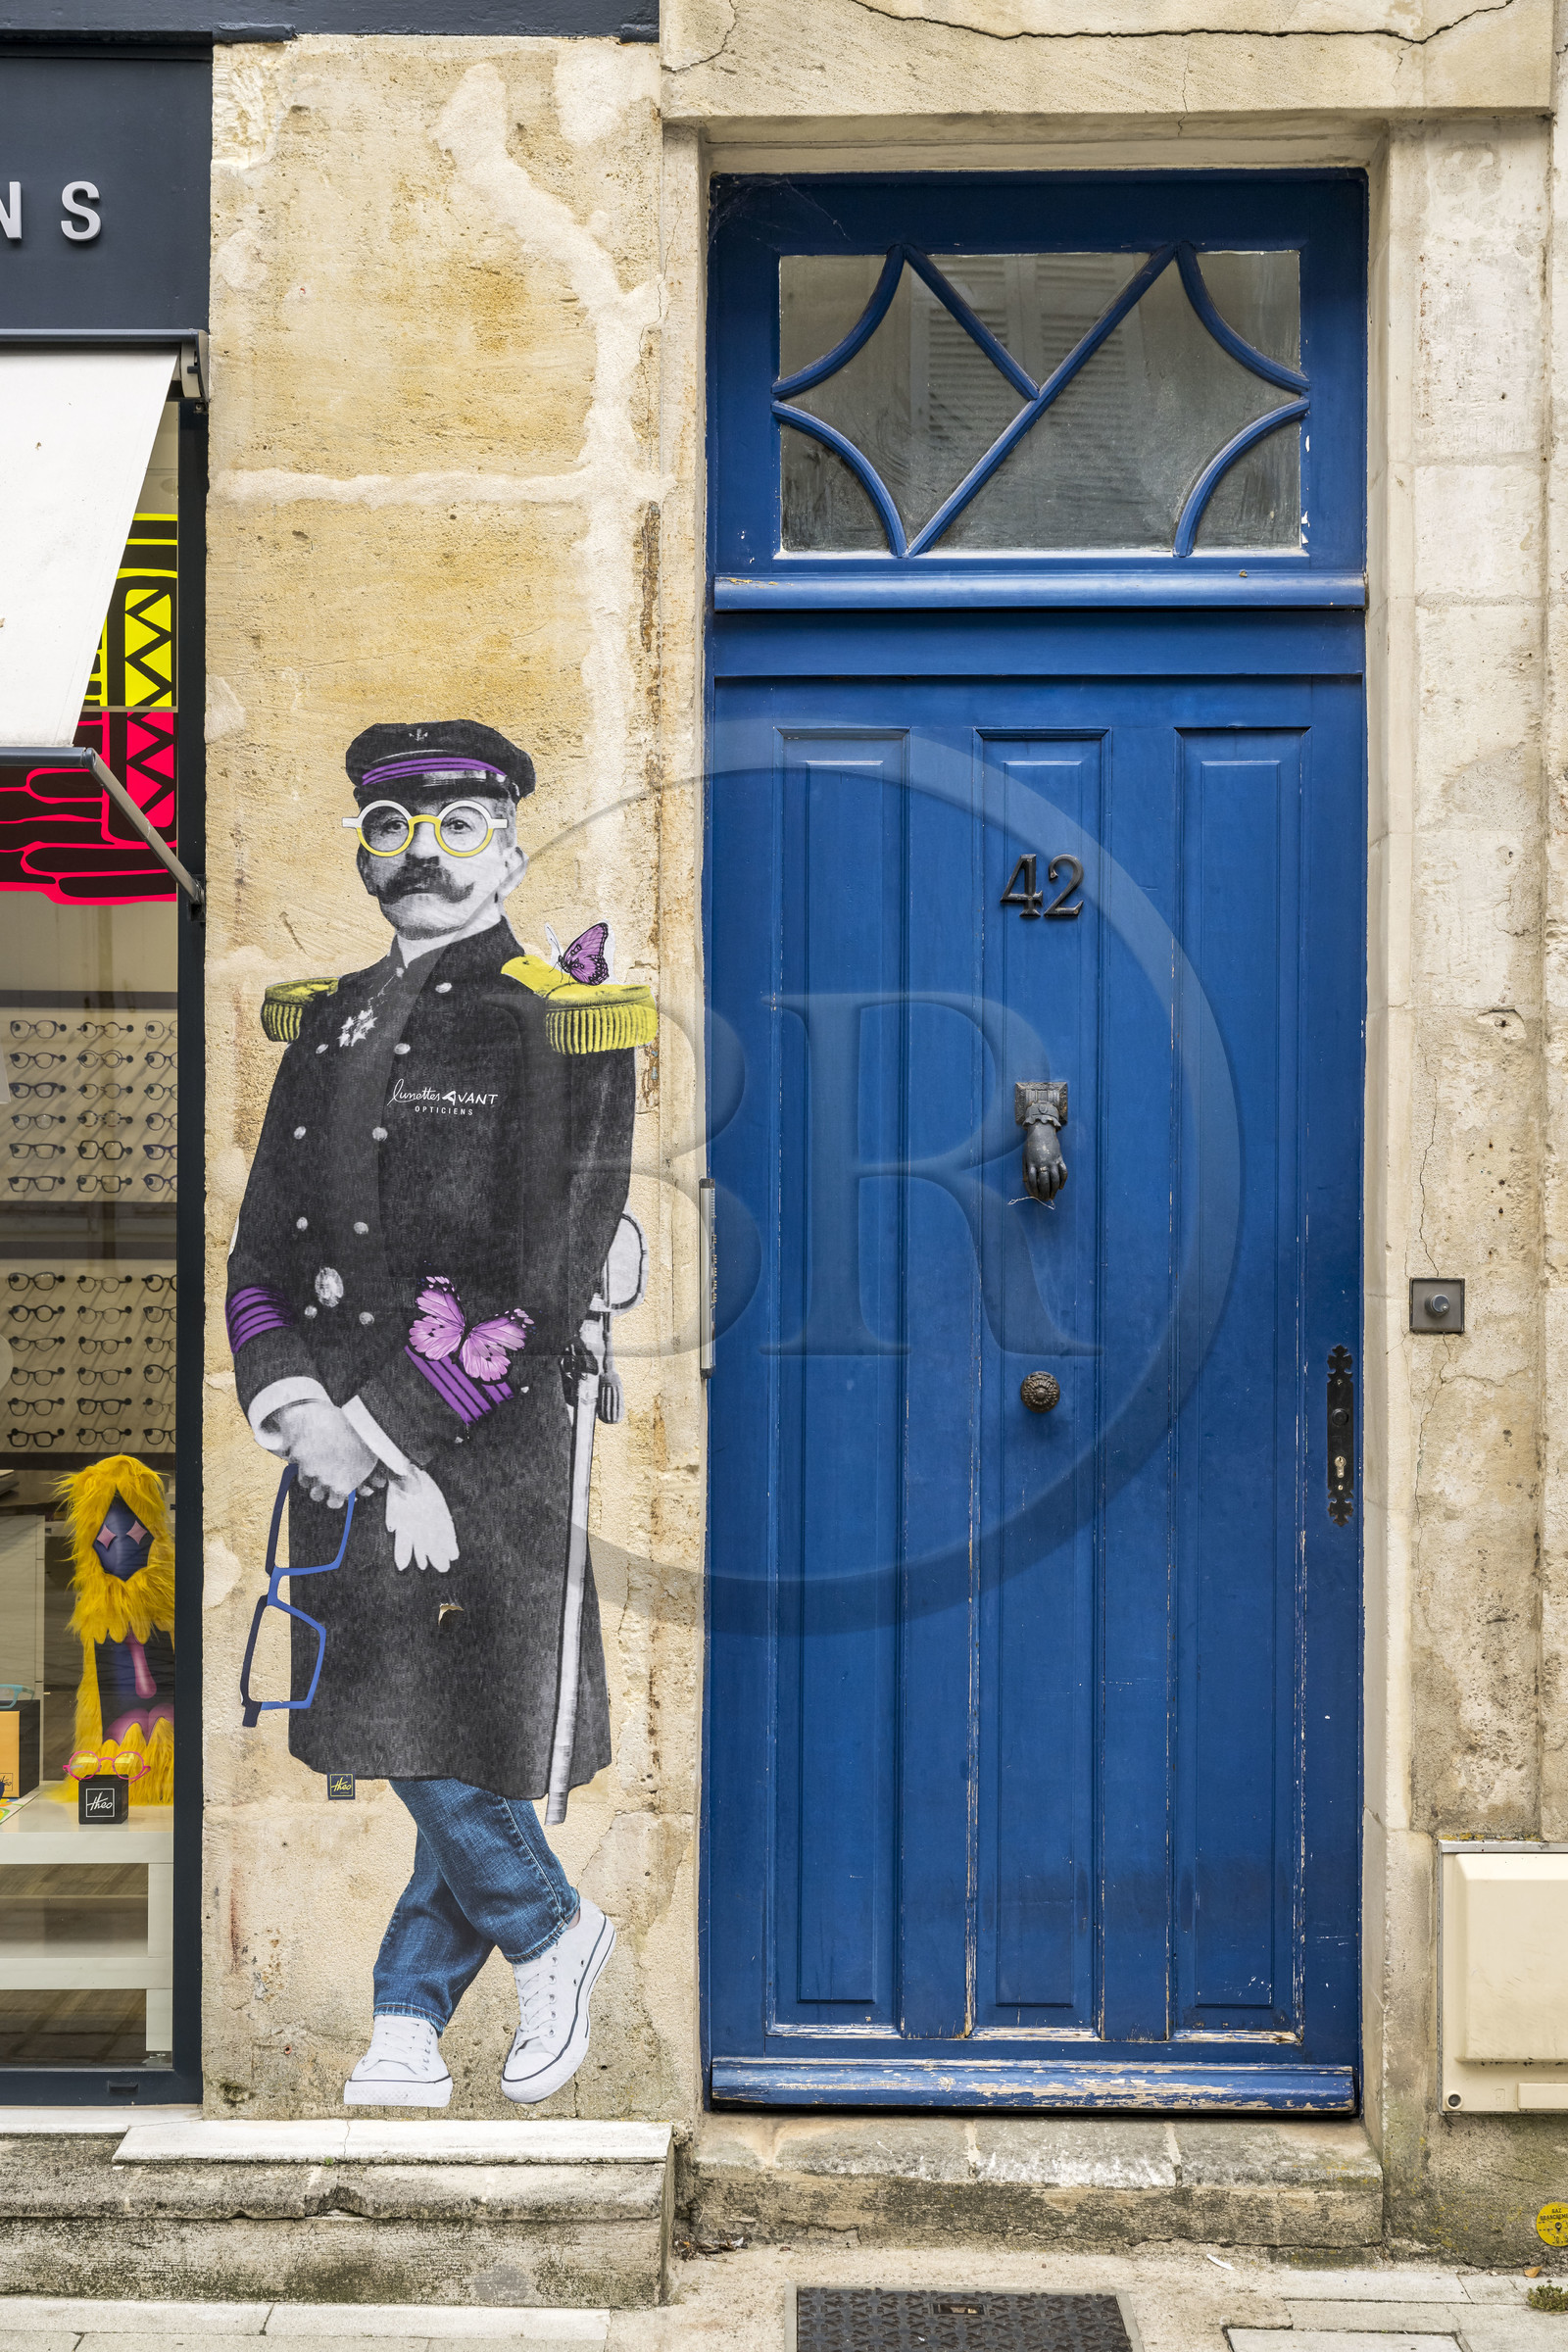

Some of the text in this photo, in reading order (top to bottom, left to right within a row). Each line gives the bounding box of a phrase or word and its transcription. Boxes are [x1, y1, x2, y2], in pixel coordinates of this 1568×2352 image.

[1000, 854, 1084, 917] 42
[442, 1090, 498, 1106] AVANT
[415, 1105, 473, 1116] OPTICIENS
[330, 1776, 352, 1792] theo
[87, 1790, 113, 1811] theo
